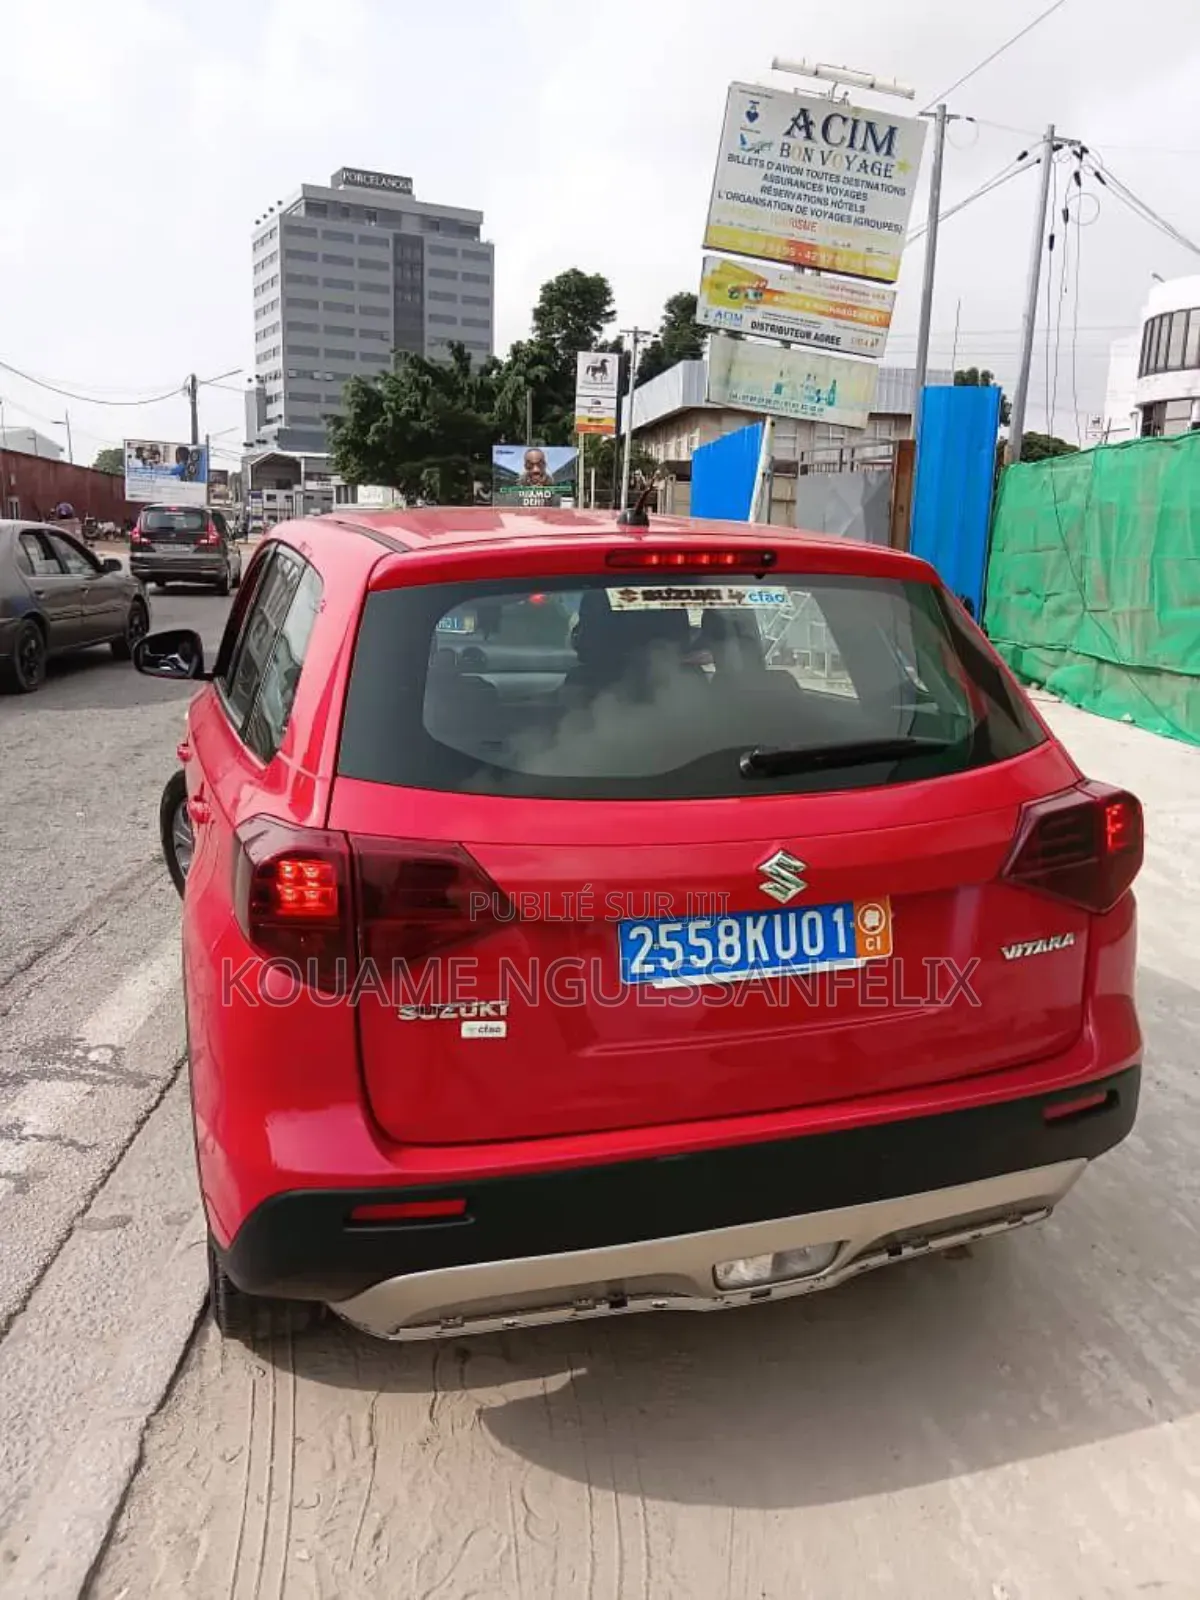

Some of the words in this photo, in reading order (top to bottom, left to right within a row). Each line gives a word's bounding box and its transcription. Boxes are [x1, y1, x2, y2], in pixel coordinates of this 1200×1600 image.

[783, 107, 898, 159] ACIM
[727, 153, 765, 169] BILLETS
[767, 160, 804, 177] D'AVION
[805, 168, 841, 184] TOUTES
[842, 174, 906, 197] DESTINATIONS
[780, 142, 814, 167] BON
[820, 150, 895, 179] VOYAGE
[760, 185, 829, 206] RÉSERVATIONS
[830, 197, 866, 214] HÔTELS
[762, 173, 823, 193] ASSURANCES
[825, 185, 868, 202] VOYAGES
[795, 204, 809, 216] DE
[810, 206, 852, 224] VOYAGES
[751, 320, 812, 340] DISTRIBUTEUR
[629, 907, 847, 974] 2558KU01
[1001, 932, 1075, 960] VITARA
[398, 1000, 509, 1021] SUZUKI
